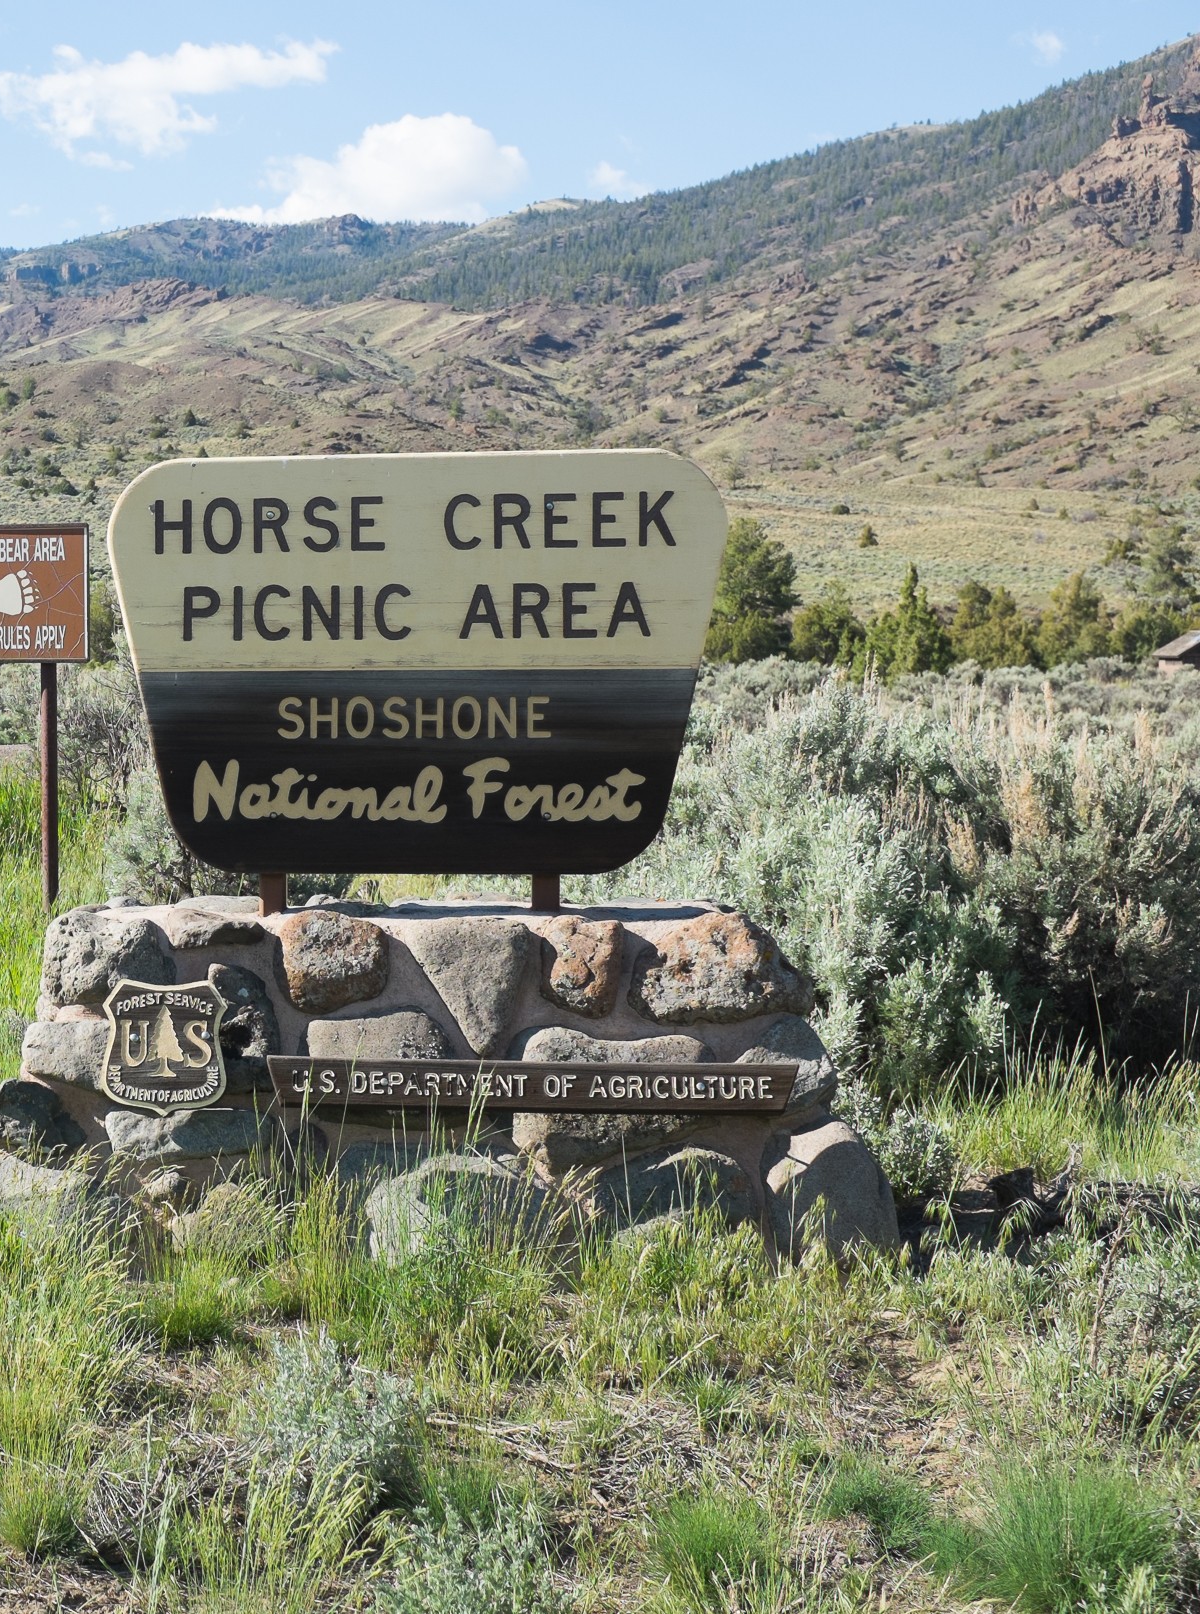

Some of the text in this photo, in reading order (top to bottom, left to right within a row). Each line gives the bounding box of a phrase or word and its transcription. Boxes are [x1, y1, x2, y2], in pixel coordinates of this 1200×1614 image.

[153, 490, 678, 555] HORSE CREEK
[33, 537, 66, 562] AREA
[182, 581, 651, 642] PICNIC AREA
[34, 624, 67, 650] APPLY
[277, 695, 552, 740] SHOSHONE
[193, 756, 646, 824] National Forest
[116, 992, 214, 1016] FOREST SERVICE
[108, 1064, 219, 1103] DEPARTMENT OF AGRICULTURE
[292, 1069, 774, 1100] U.S. DEPARTMENT OF AGRICULTURE
